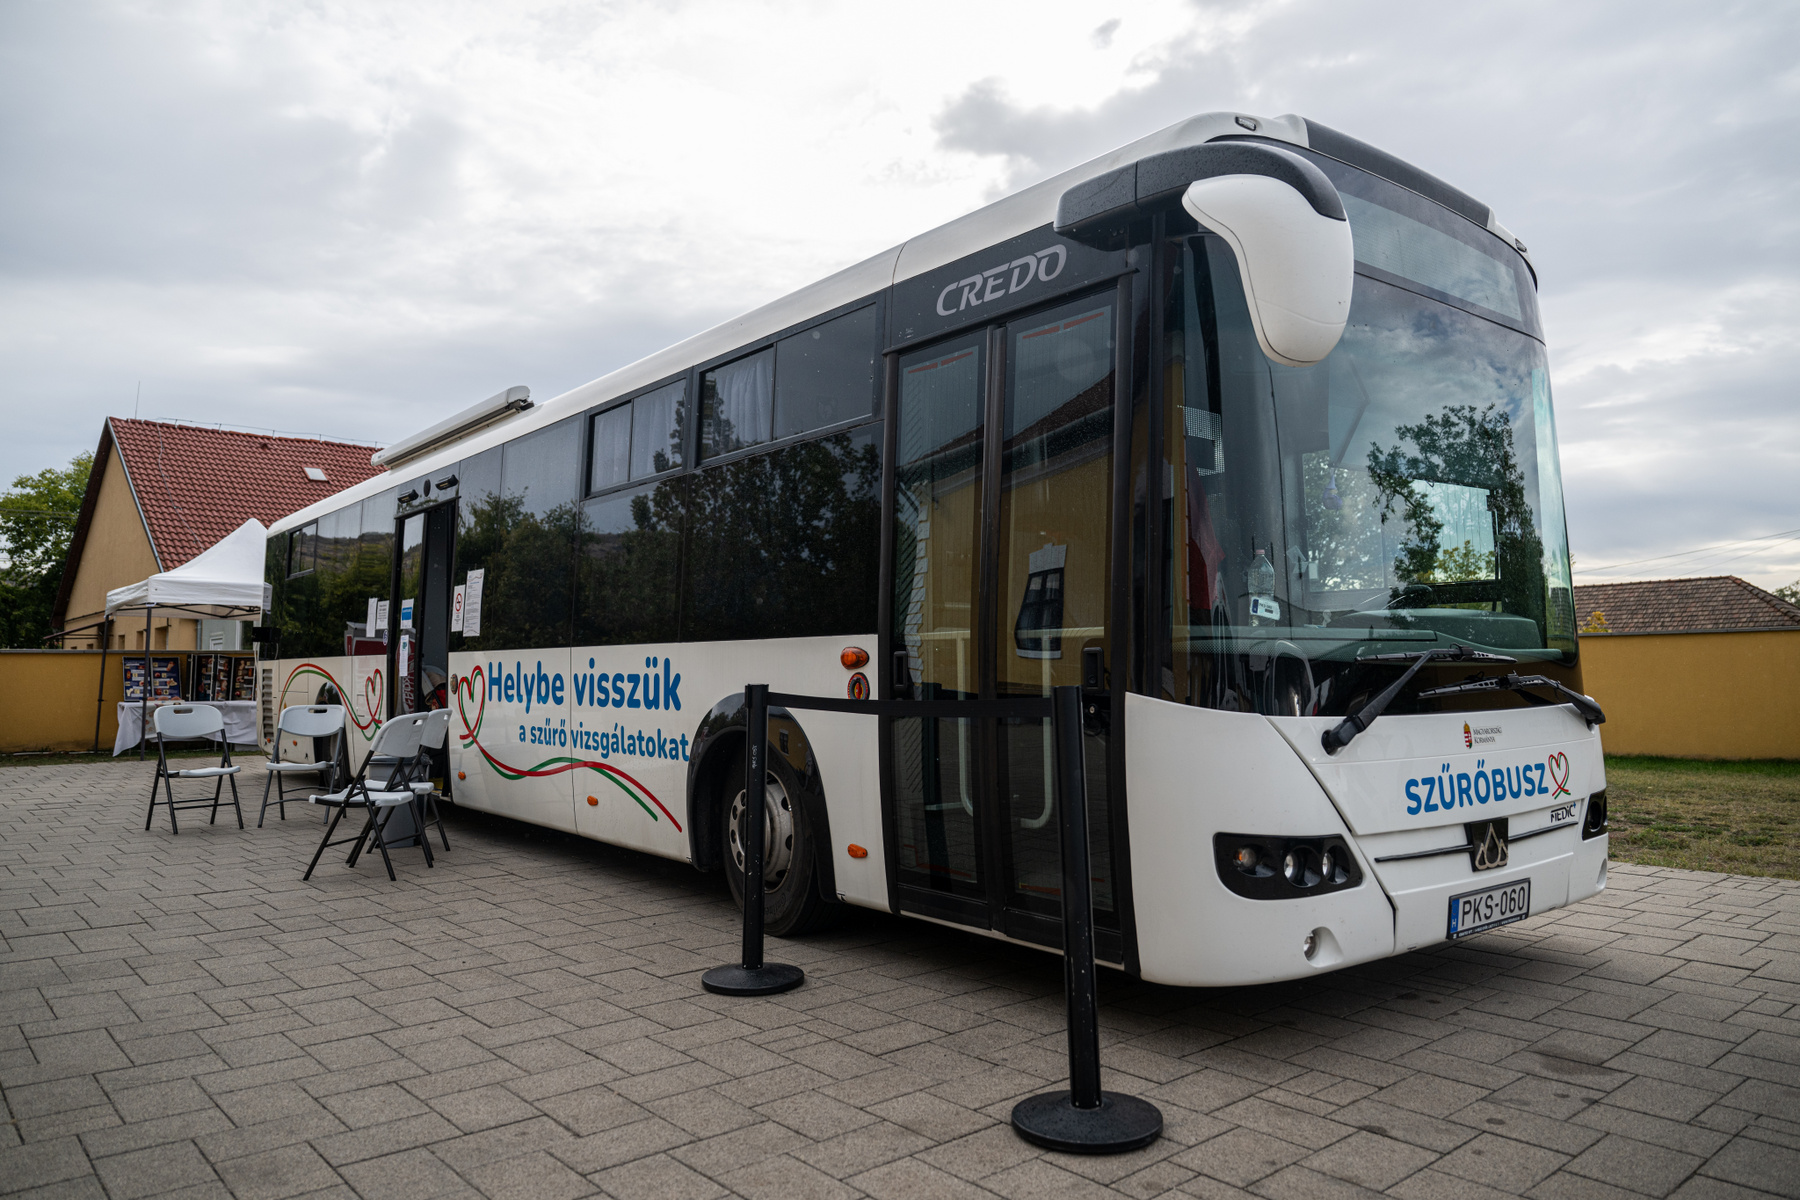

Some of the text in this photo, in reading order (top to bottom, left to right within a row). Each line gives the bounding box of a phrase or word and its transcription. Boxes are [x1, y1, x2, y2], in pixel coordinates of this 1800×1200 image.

[936, 244, 1067, 316] CREDO
[488, 656, 682, 714] Helybe visszük
[519, 718, 690, 762] a szűrő vizsgálatokat
[1405, 759, 1548, 816] SZŰRŐBUSZ
[1462, 886, 1526, 927] PKS-060
